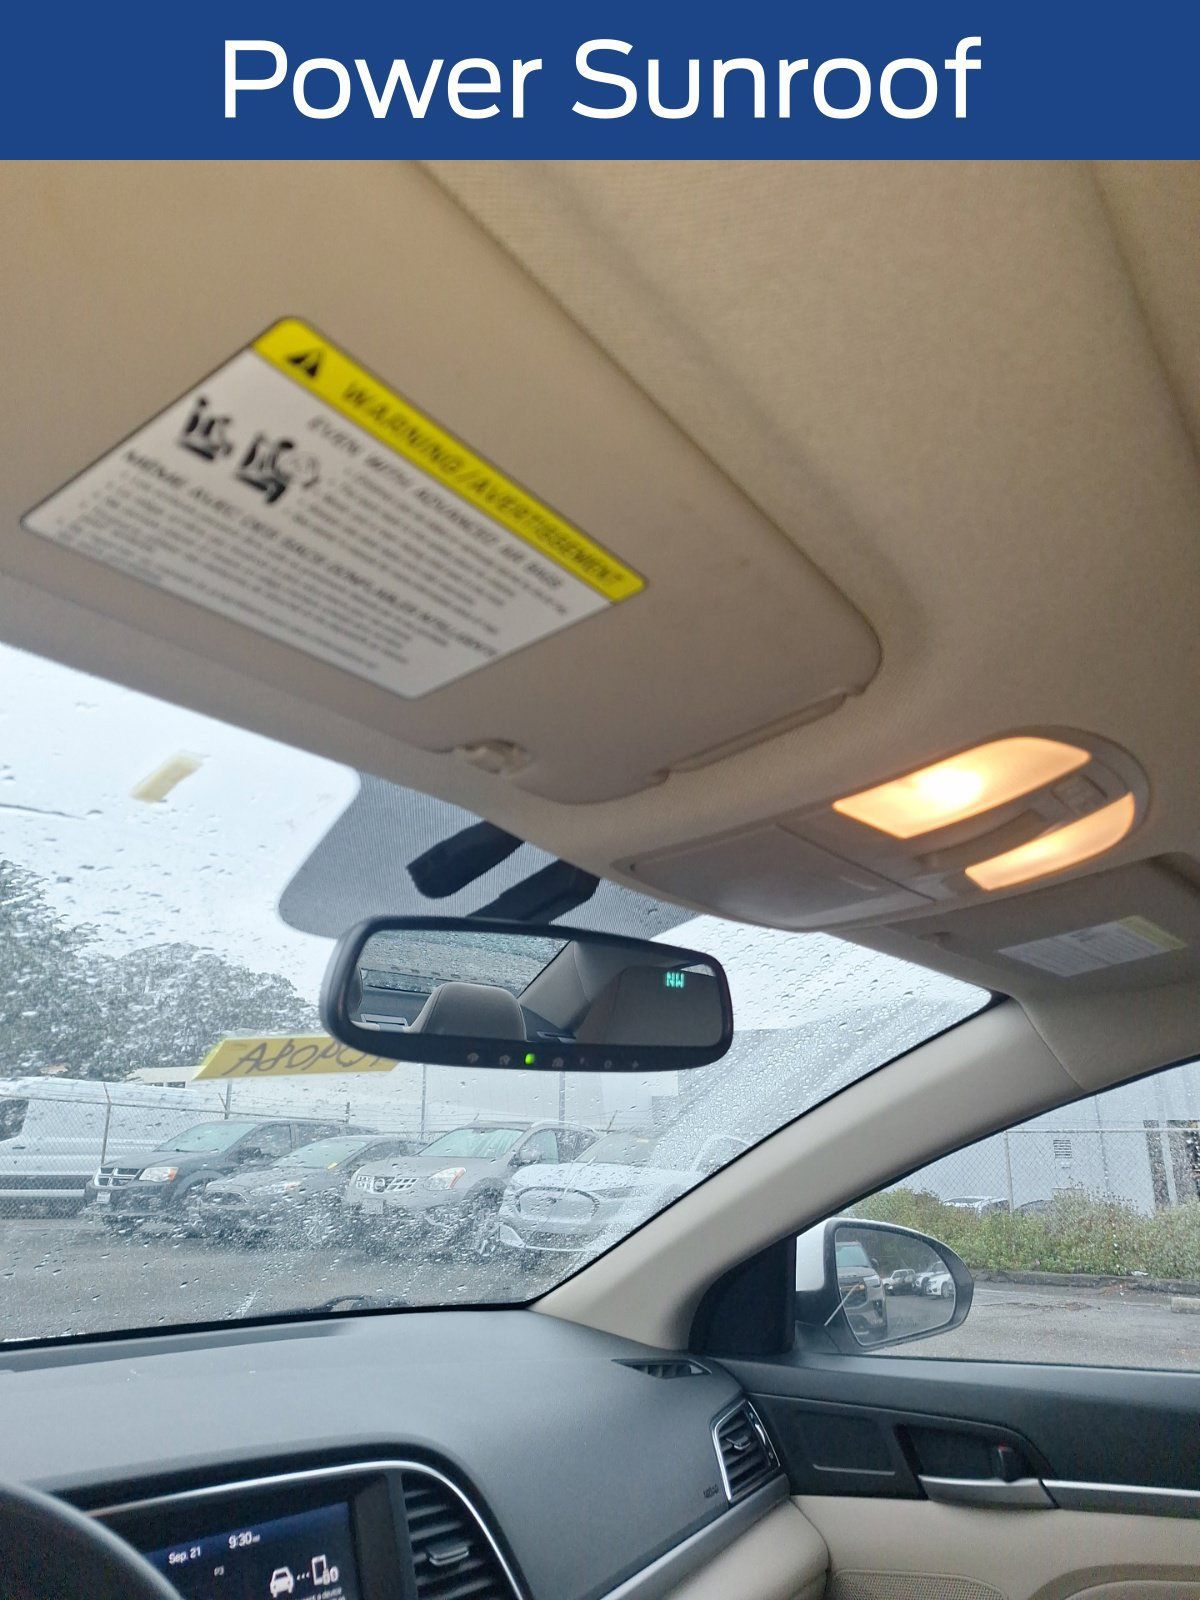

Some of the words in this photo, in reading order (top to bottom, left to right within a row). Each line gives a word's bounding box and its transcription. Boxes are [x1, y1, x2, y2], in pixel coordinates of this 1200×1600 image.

[666, 971, 685, 988] NW
[228, 1531, 252, 1549] 9:30
[169, 1551, 188, 1565] Sep.
[190, 1546, 200, 1559] 21
